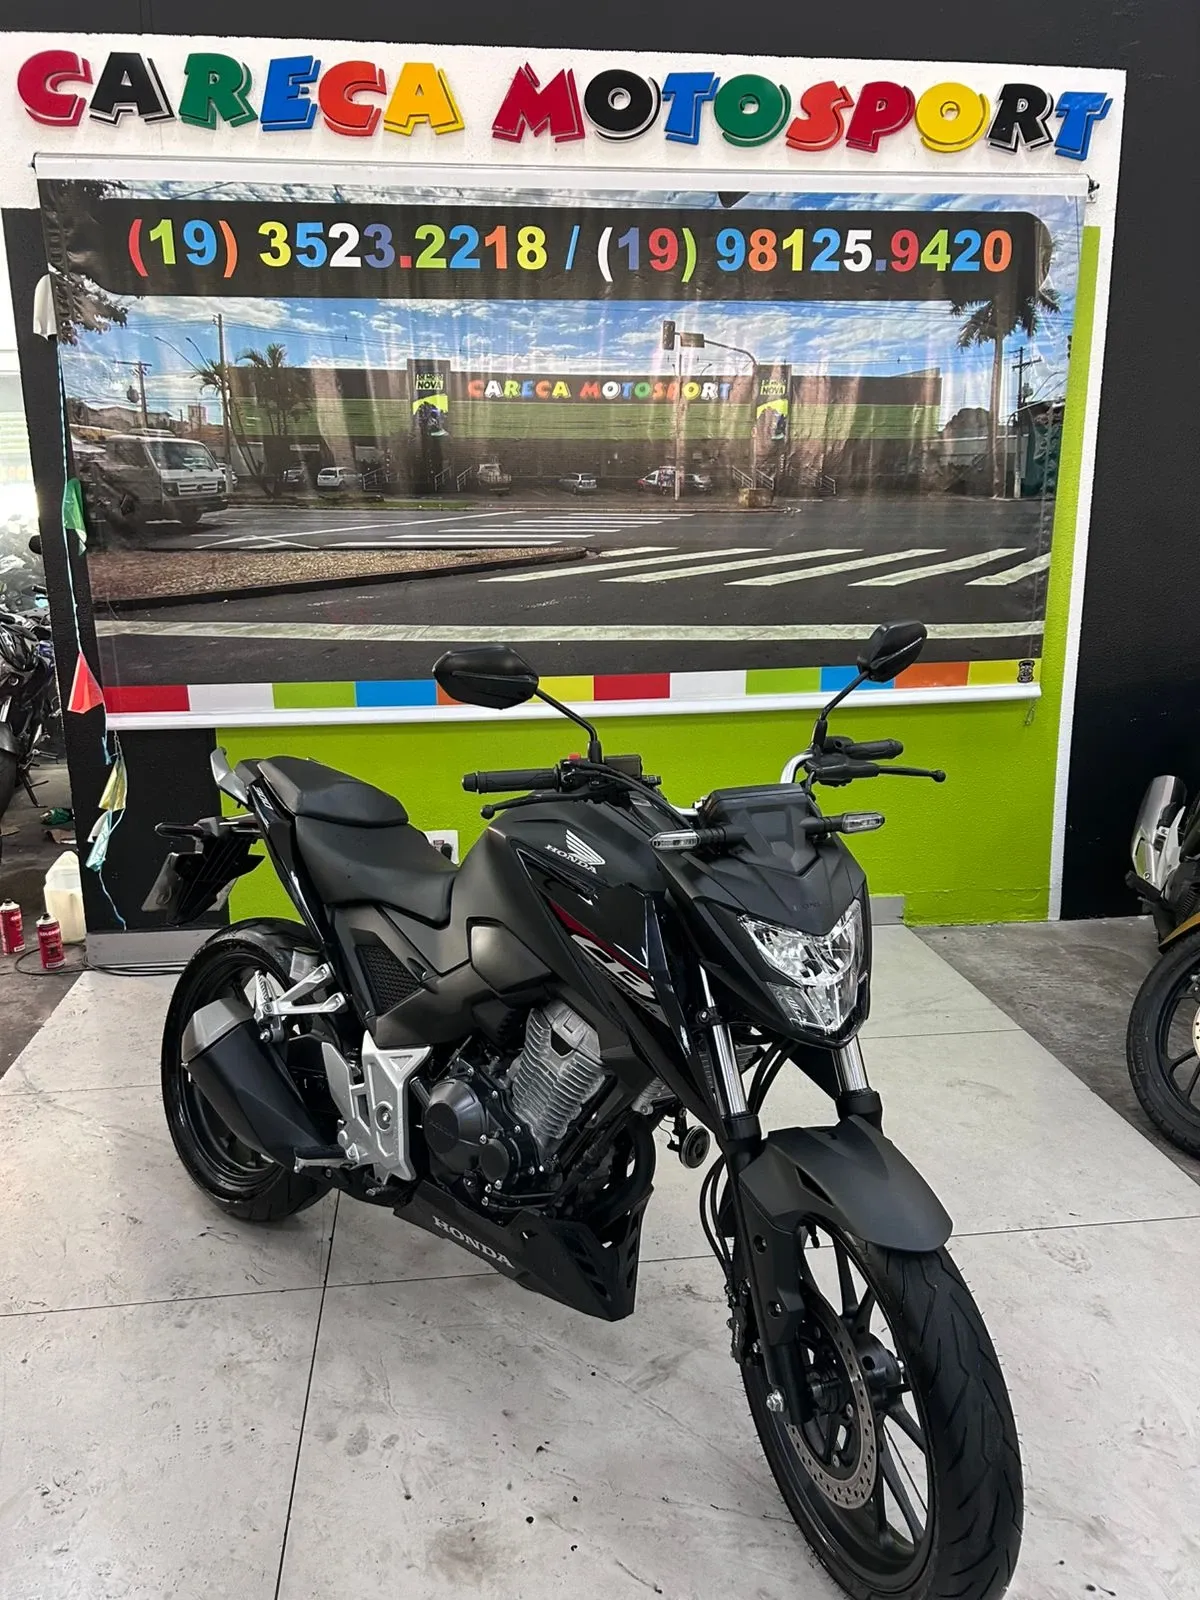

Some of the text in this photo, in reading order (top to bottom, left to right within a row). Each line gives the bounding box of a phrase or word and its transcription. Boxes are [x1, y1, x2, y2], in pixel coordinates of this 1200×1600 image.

[17, 50, 1113, 161] CARECA MOTOSPORT
[128, 218, 1012, 283] (19) 3523.2218 / (19) 98125.9420
[417, 381, 442, 389] NOVA
[467, 380, 731, 400] CARECA MOTOSPORT
[544, 844, 597, 875] HONDA
[432, 1215, 515, 1269] HONDA
